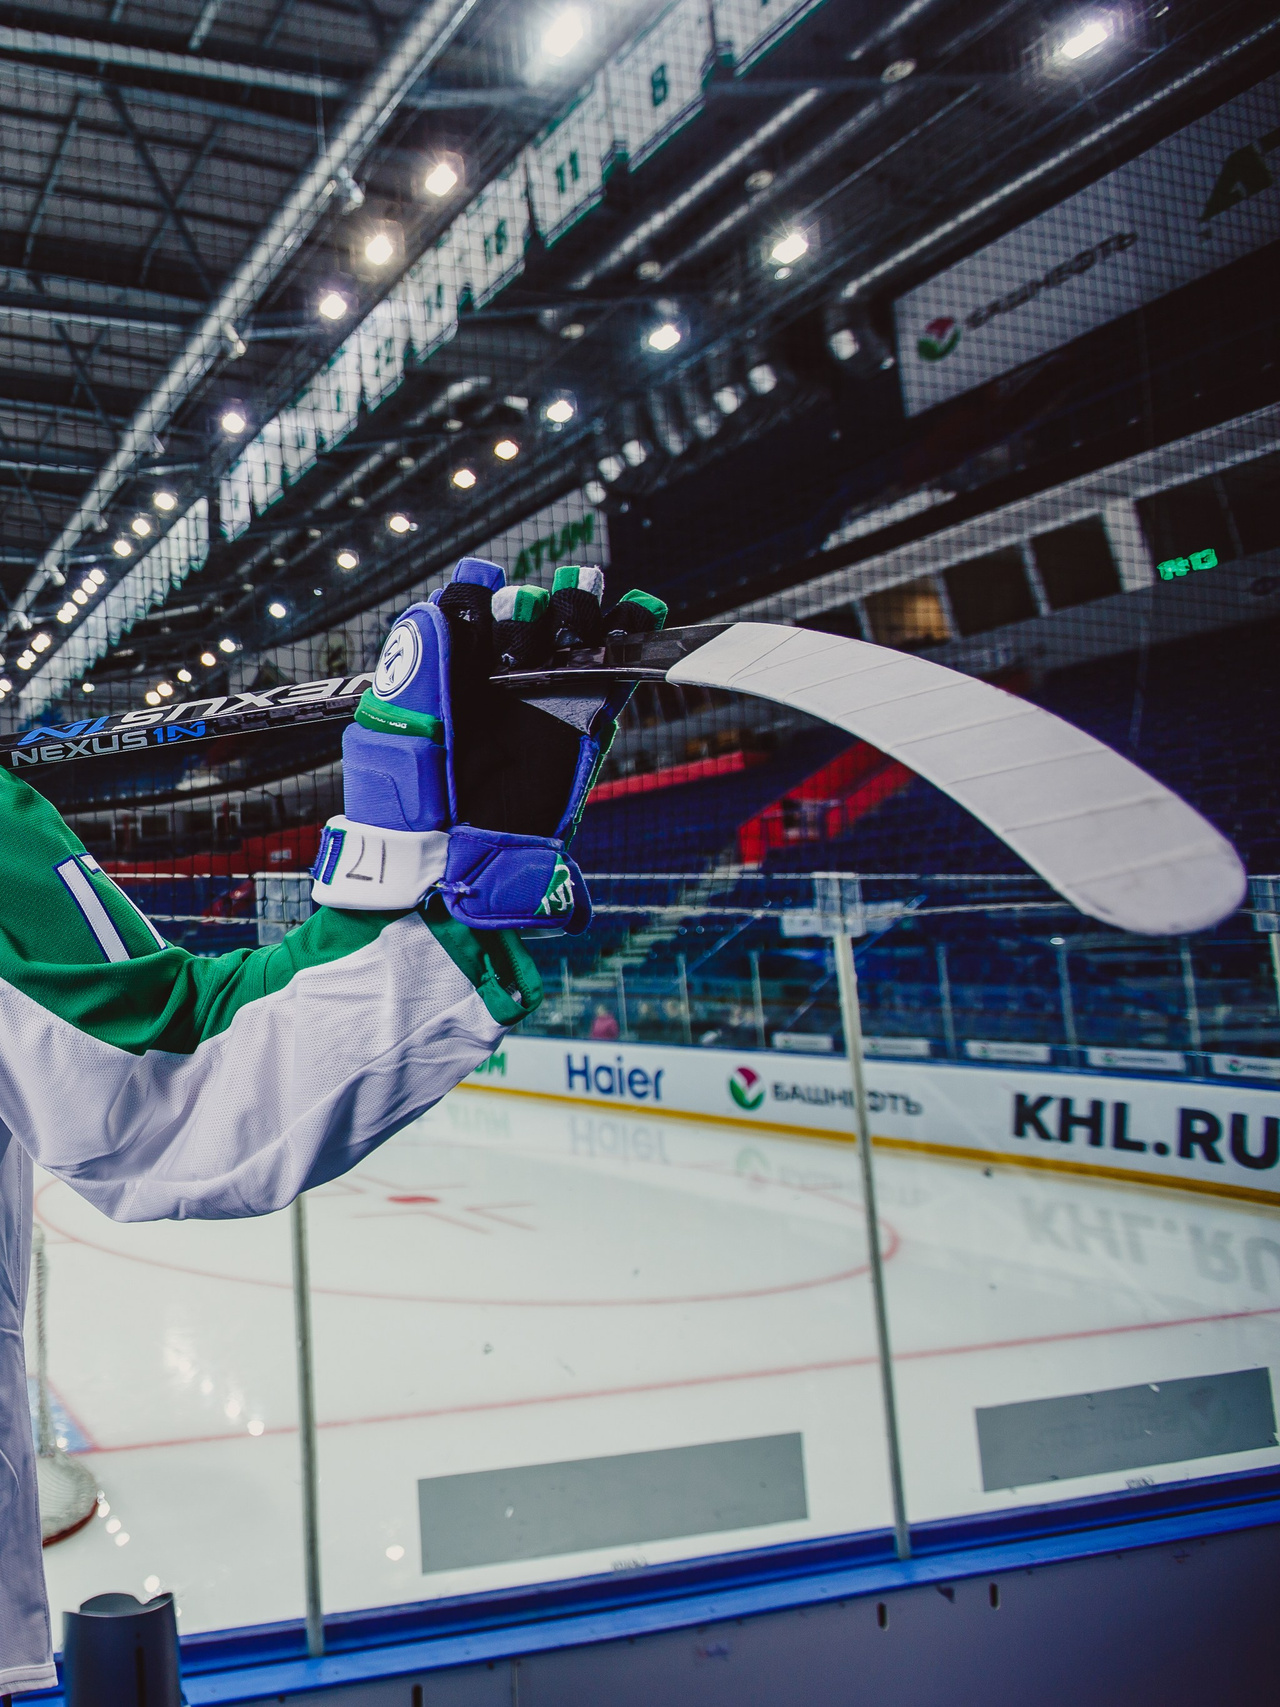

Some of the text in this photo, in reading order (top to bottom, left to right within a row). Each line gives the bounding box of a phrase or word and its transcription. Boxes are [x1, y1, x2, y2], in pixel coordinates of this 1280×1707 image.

[10, 729, 149, 767] NEXUS
[566, 1053, 665, 1101] Haier
[772, 1081, 923, 1115] БАШНФТЬ
[1012, 1092, 1280, 1171] KHL.RU
